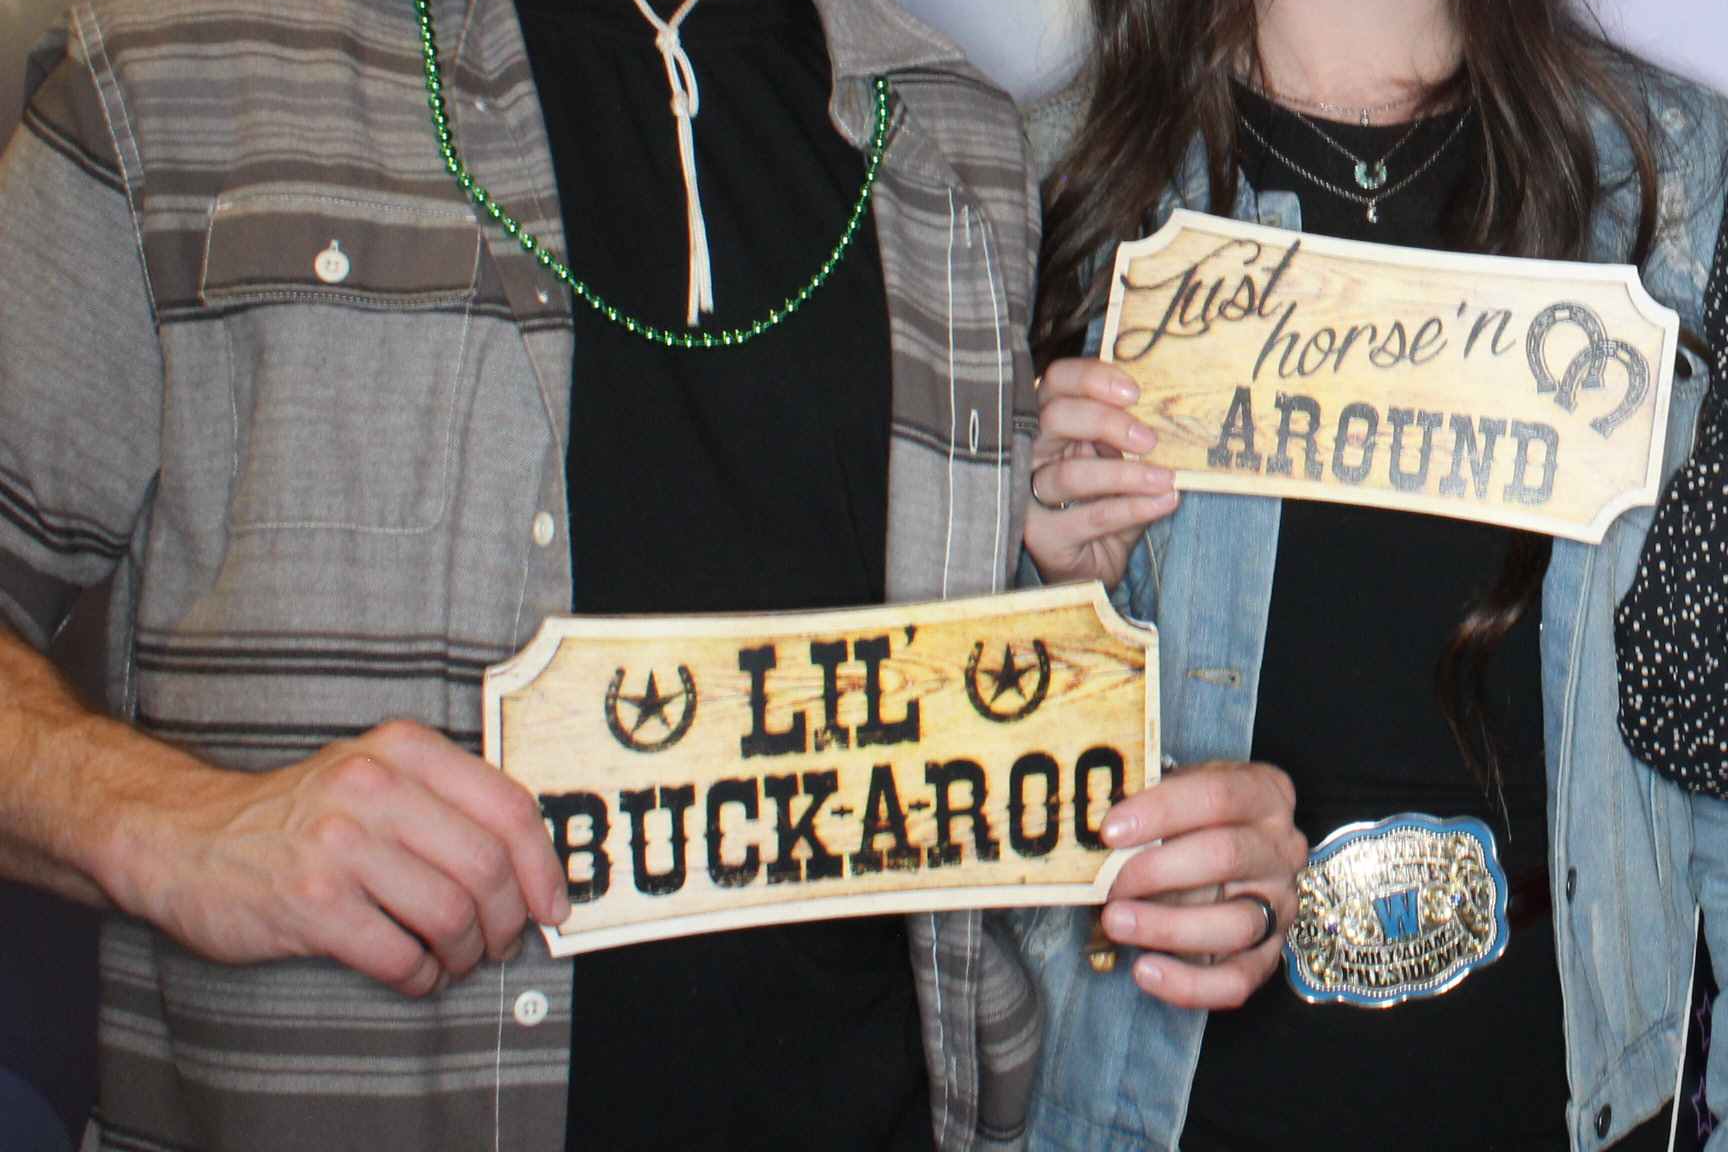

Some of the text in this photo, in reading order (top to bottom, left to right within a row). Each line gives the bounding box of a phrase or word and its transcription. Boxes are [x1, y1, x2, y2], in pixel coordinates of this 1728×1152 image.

[1113, 238, 1300, 361] Just
[1252, 300, 1516, 381] horse'n
[1207, 385, 1560, 506] AROUND
[739, 623, 921, 759] LIL'
[540, 746, 1126, 905] BUCK-A-ROO
[1373, 887, 1420, 941] W
